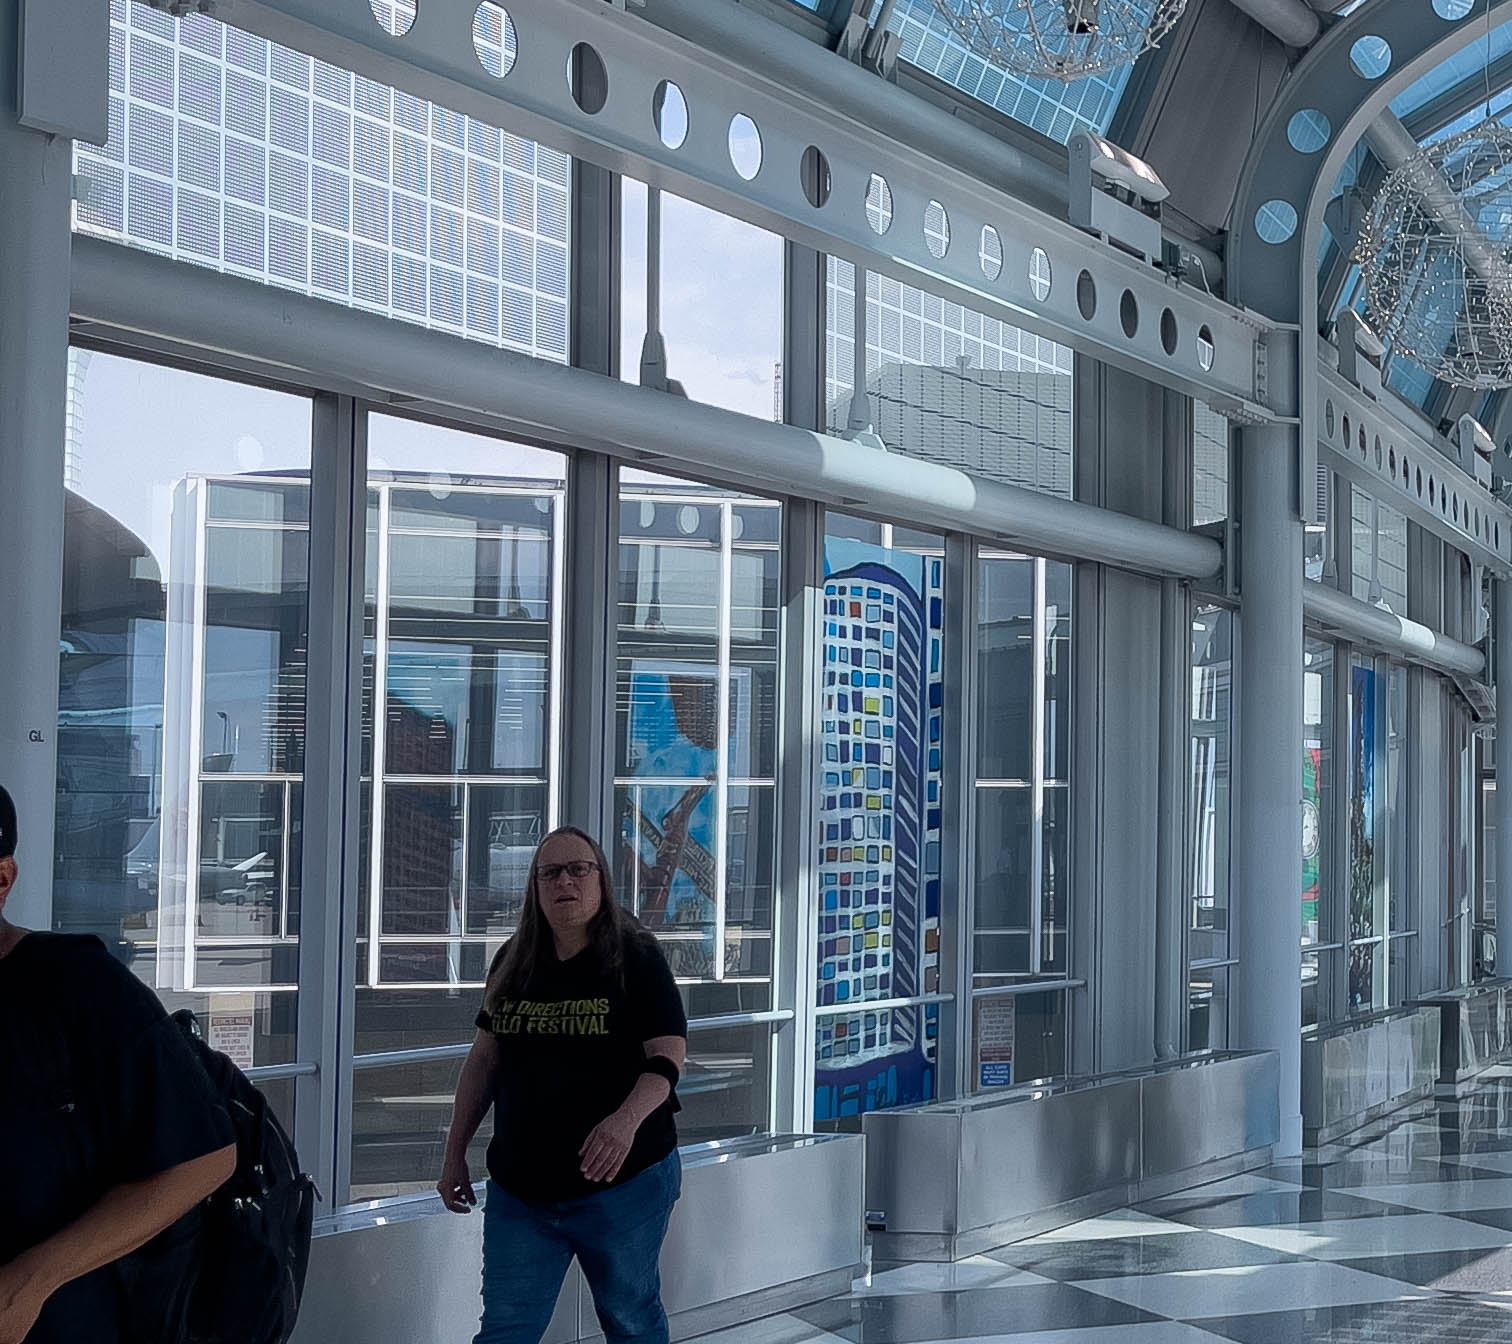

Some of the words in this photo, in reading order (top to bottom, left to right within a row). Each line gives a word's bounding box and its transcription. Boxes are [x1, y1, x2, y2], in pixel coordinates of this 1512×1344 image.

[516, 998, 610, 1016] DIRECTIONS
[491, 1014, 522, 1034] ELLO
[526, 1015, 609, 1035] FESTIVAL
